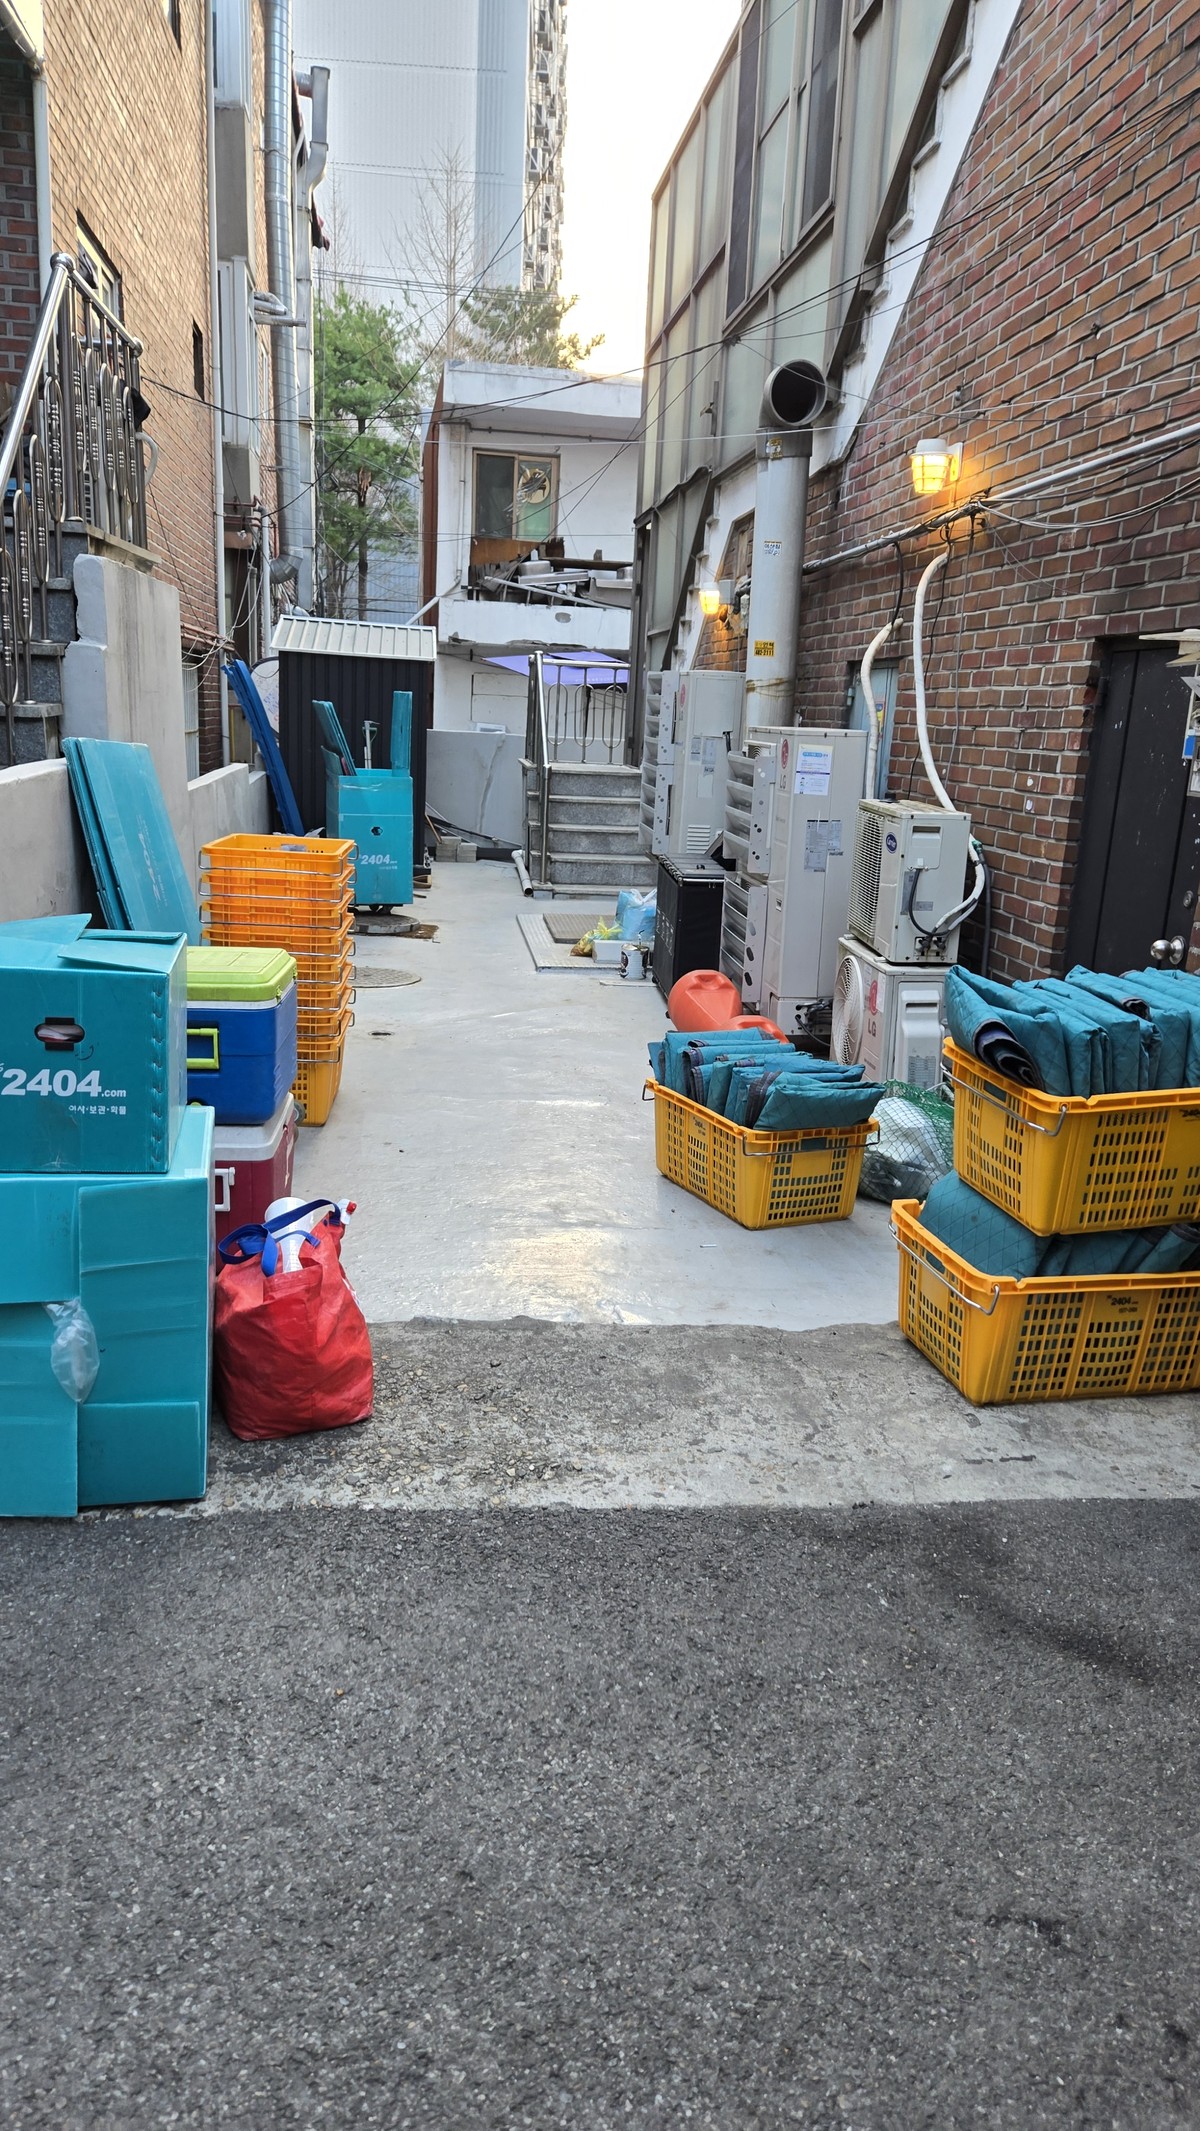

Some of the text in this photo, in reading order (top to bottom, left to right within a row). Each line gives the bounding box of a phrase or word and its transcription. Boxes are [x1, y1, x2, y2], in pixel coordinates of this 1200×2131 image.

[780, 773, 787, 789] LG
[867, 1018, 877, 1037] LG
[1, 1068, 127, 1097] 2404.com
